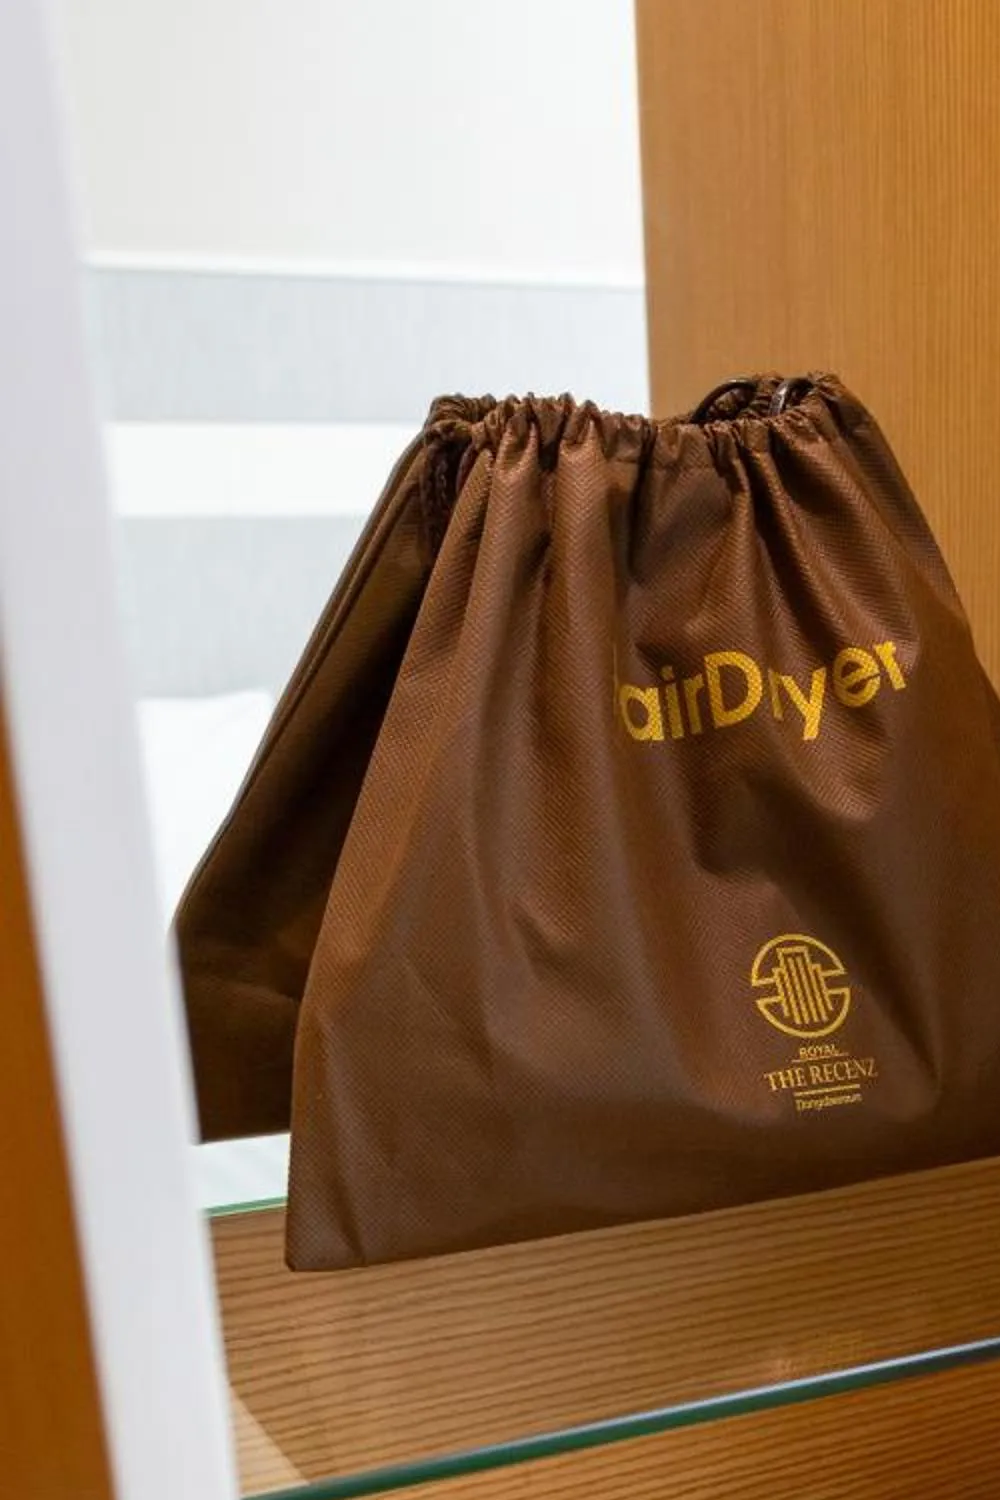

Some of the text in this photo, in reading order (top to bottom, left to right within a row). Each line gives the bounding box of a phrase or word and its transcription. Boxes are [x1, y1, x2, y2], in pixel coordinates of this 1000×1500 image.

[612, 640, 907, 741] airDryer
[799, 1043, 840, 1059] ROYAL
[764, 1058, 879, 1091] THE RECENZ
